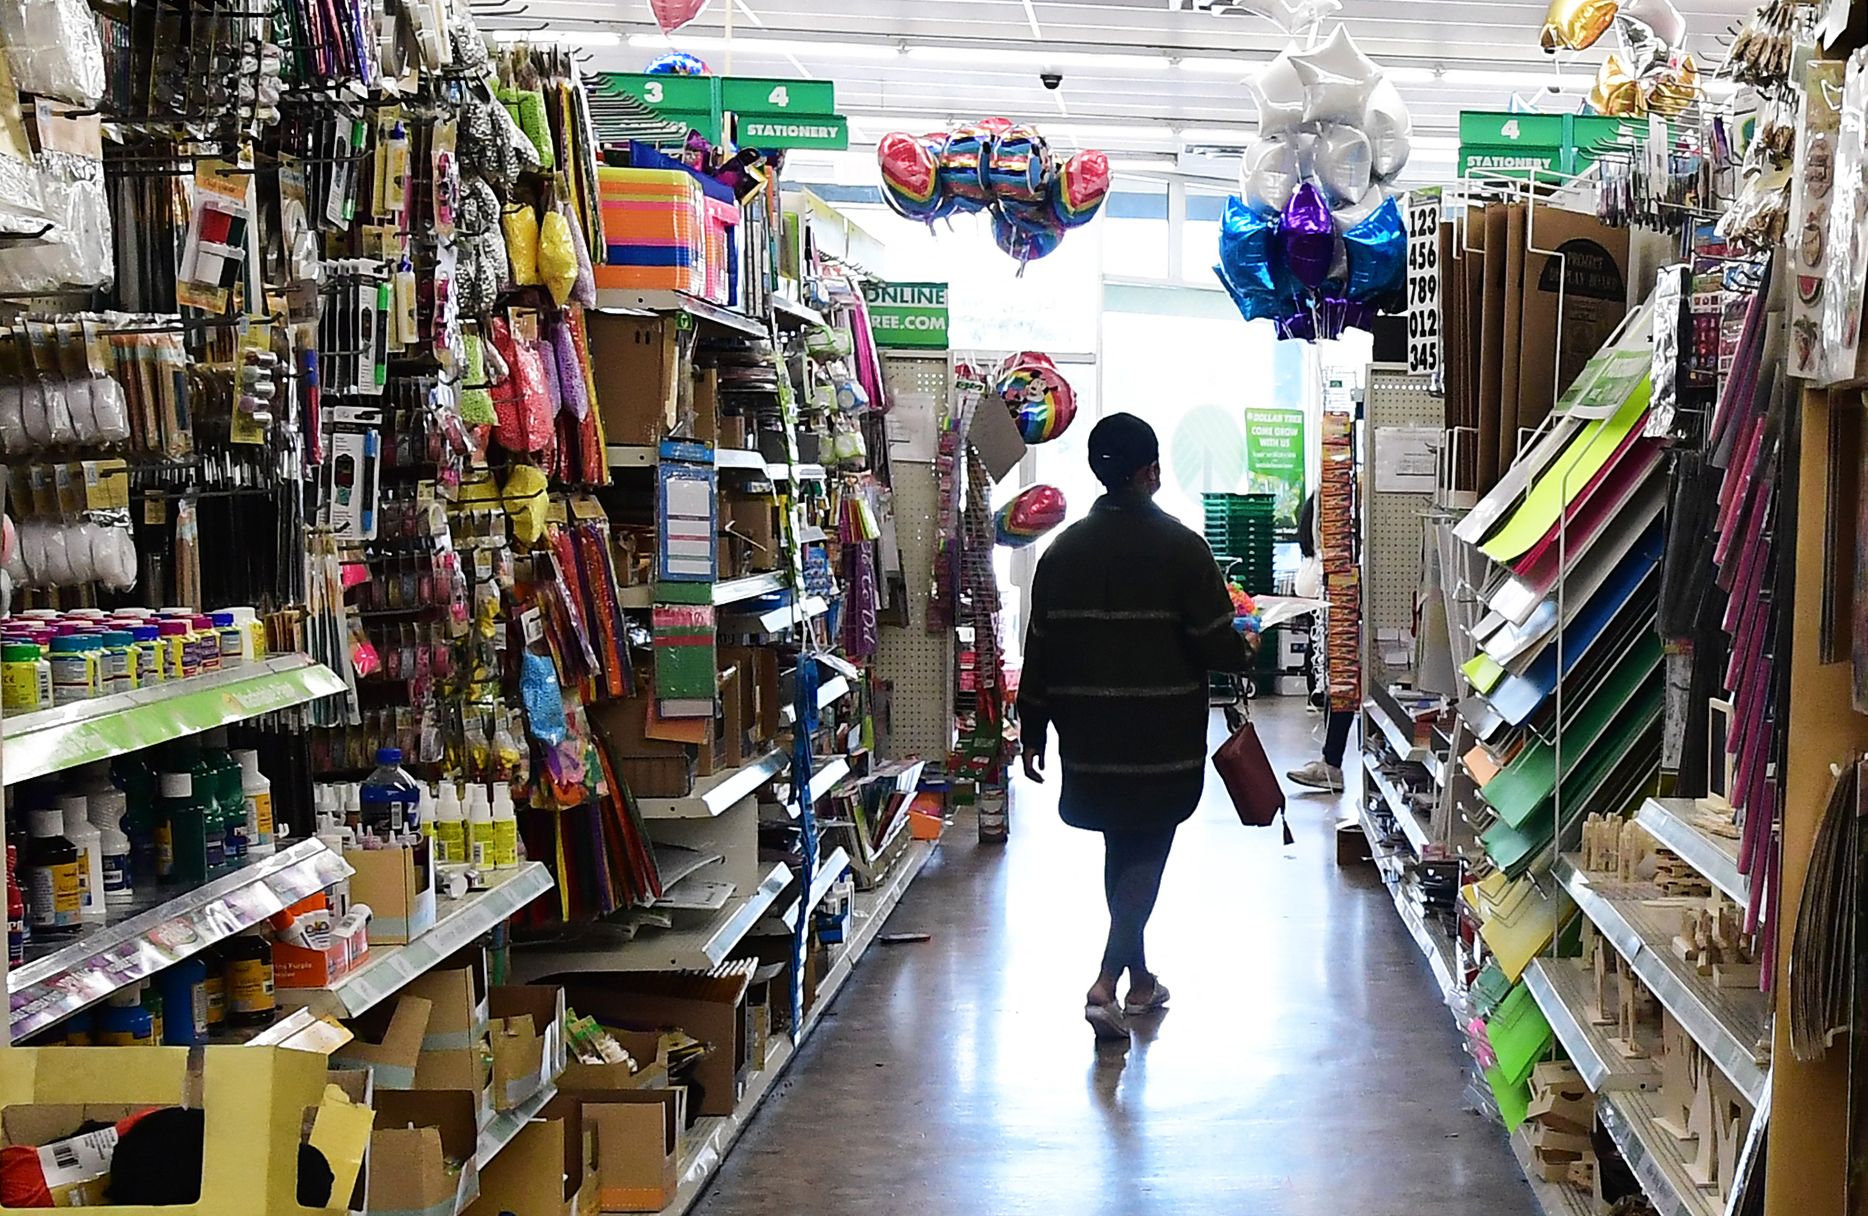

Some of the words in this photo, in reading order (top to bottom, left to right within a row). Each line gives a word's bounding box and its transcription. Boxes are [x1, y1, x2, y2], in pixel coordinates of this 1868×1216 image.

[643, 81, 664, 103] 3
[768, 86, 789, 107] 4
[747, 124, 839, 138] STATIONERY
[1500, 119, 1521, 140] 4
[1466, 155, 1552, 170] STATIONERY
[1409, 207, 1437, 238] 123
[1409, 241, 1437, 271] 456
[1409, 276, 1437, 305] 789
[1409, 309, 1437, 339] 012
[1409, 342, 1437, 372] 345
[1251, 426, 1273, 436] COME
[1274, 427, 1298, 437] GROW
[1259, 437, 1279, 447] WITH
[1279, 438, 1290, 448] US
